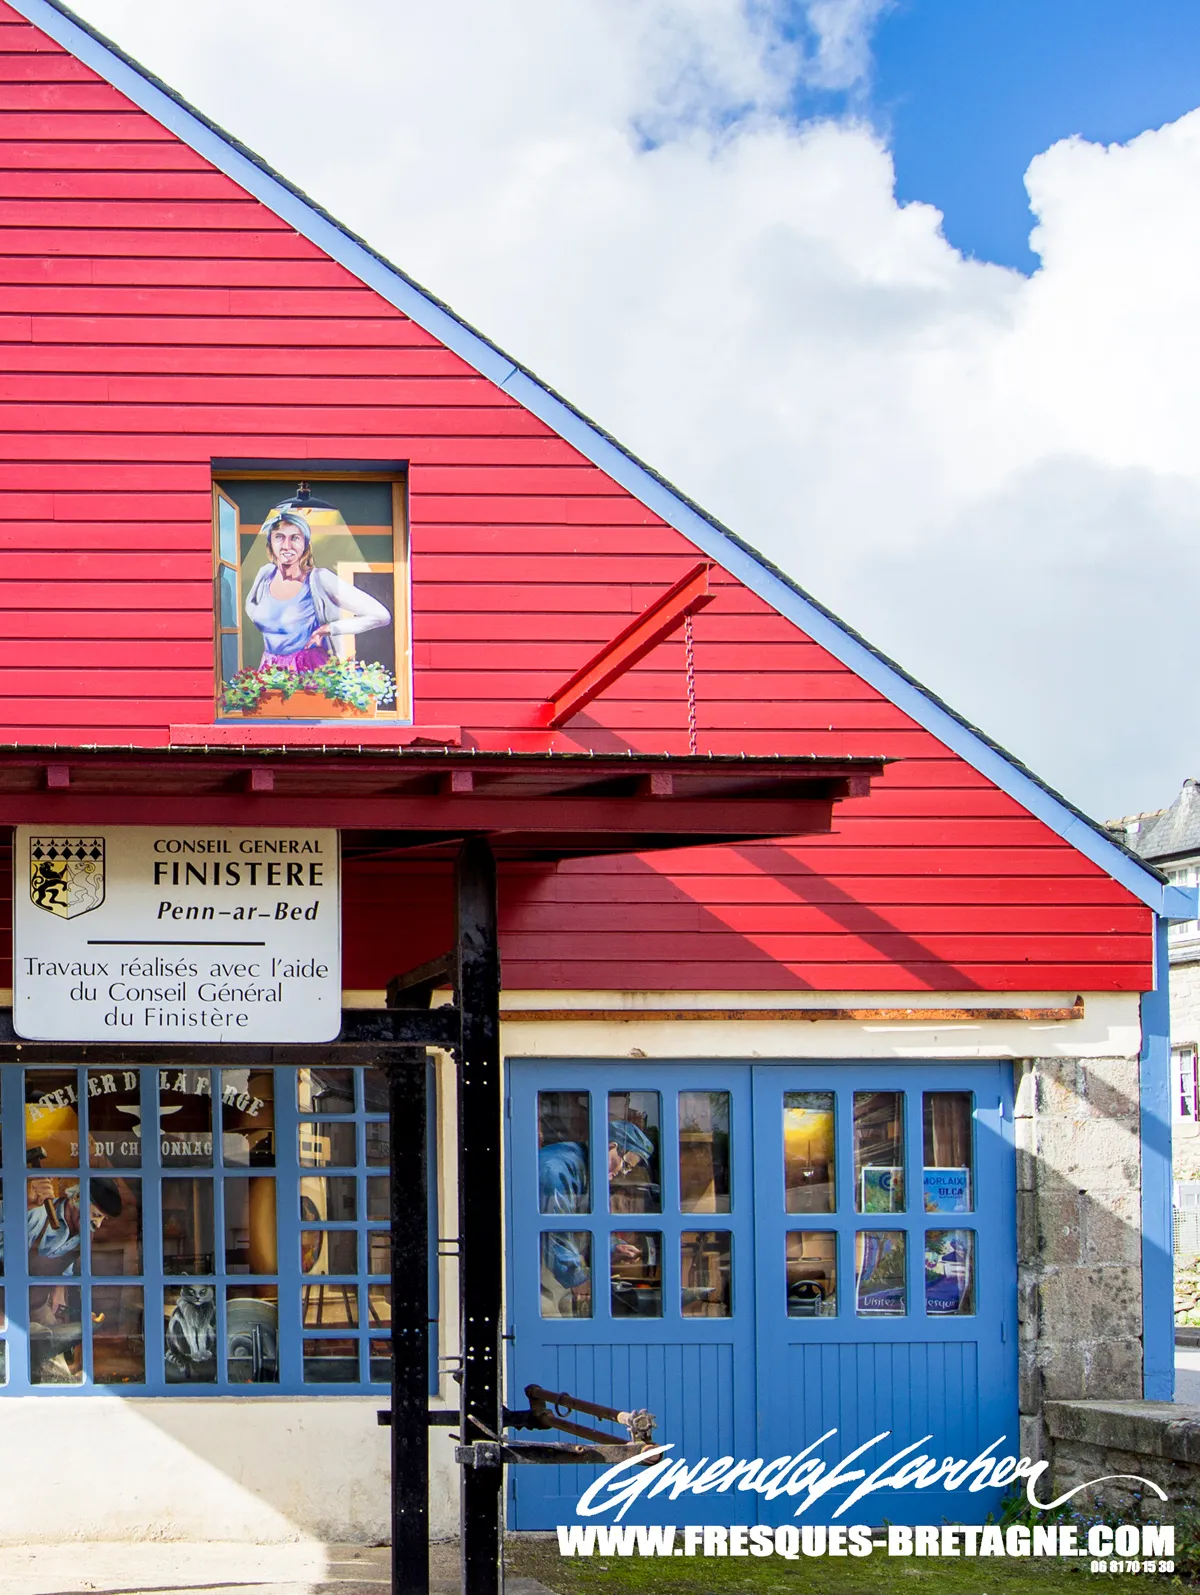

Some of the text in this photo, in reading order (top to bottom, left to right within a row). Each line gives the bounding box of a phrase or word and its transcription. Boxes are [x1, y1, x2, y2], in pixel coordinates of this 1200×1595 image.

[153, 839, 324, 854] CONSEIL GENERAL
[153, 861, 324, 887] FINISTERE
[157, 900, 320, 921] Penn-ar-Bed
[24, 956, 329, 979] Travaux réalisés avec l'aide
[69, 980, 282, 1003] du Conseil Général
[103, 1005, 249, 1028] du Finistère
[27, 1073, 117, 1123] ATELER
[159, 1071, 187, 1093] LA
[194, 1077, 265, 1117] FRGE
[94, 1141, 114, 1157] DU
